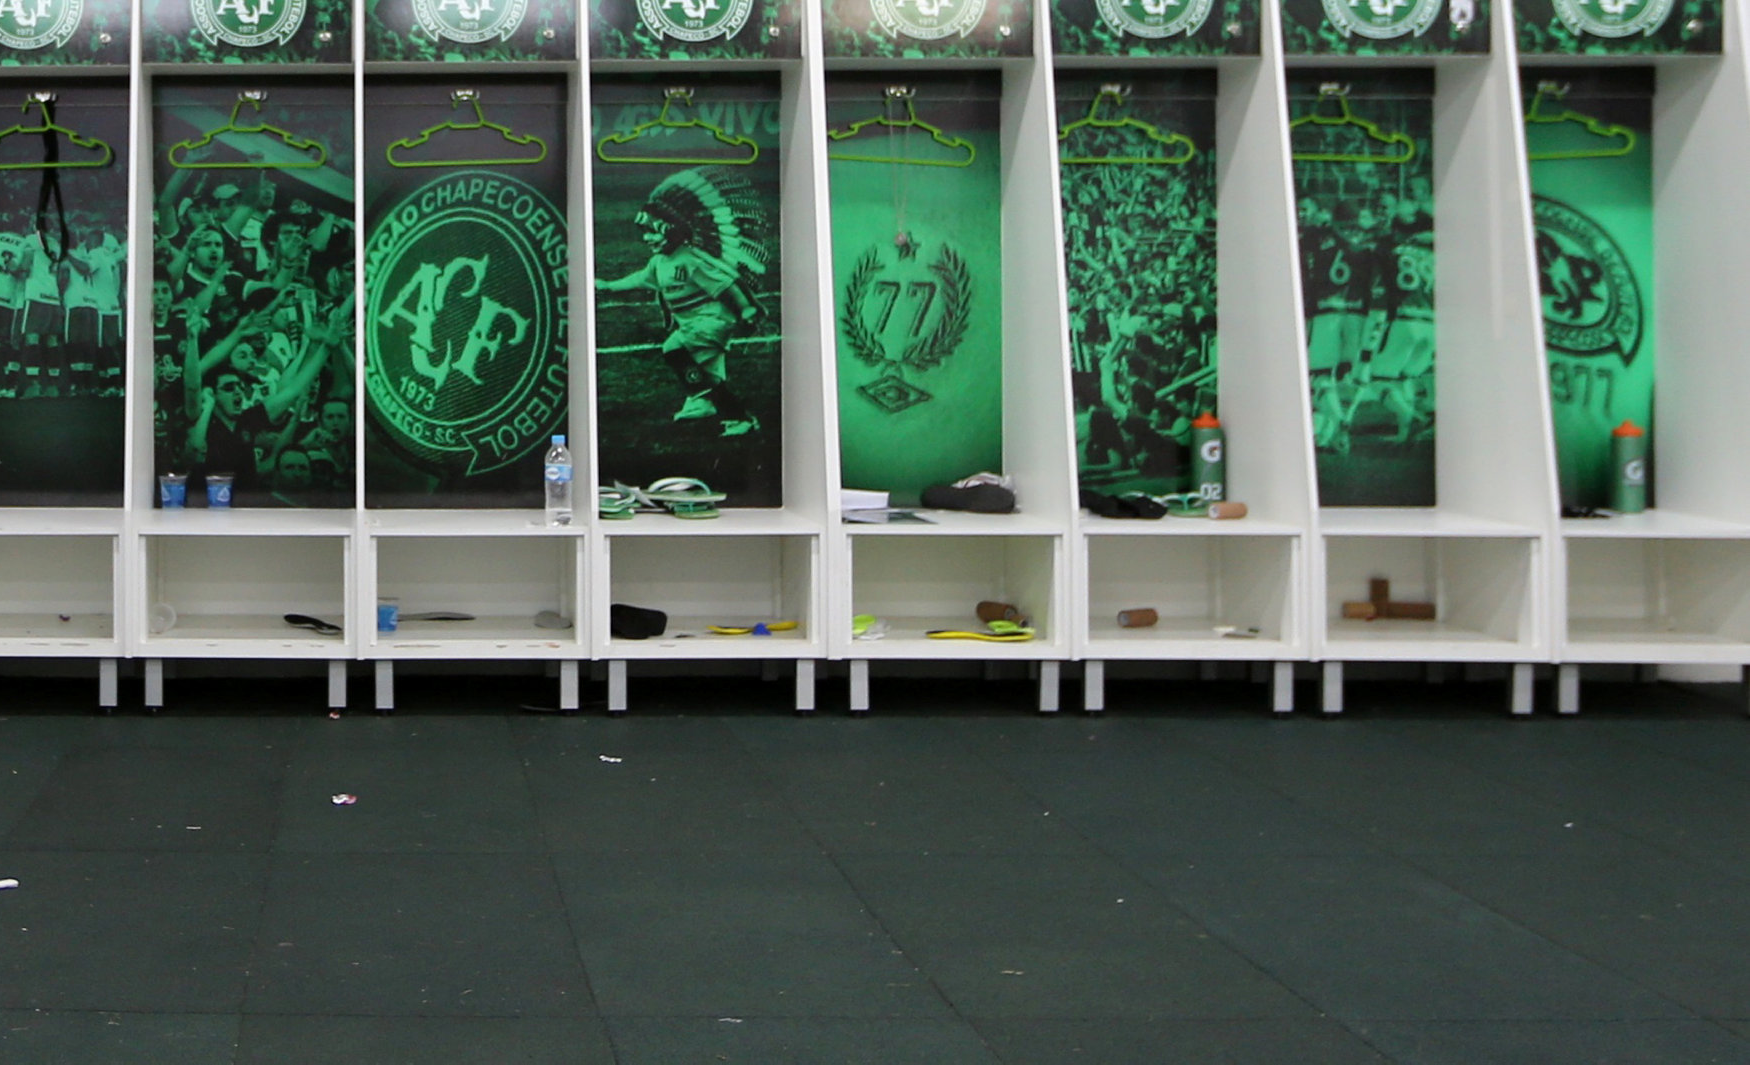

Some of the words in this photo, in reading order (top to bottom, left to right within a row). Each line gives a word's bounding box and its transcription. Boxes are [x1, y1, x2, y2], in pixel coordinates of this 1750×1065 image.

[1329, 249, 1351, 286] 6
[379, 253, 532, 391] ACF
[874, 281, 936, 336] 77
[399, 376, 436, 411] 1973
[1549, 361, 1614, 419] 977
[434, 426, 457, 444] SC
[1200, 439, 1221, 463] G
[1200, 483, 1222, 500] 02
